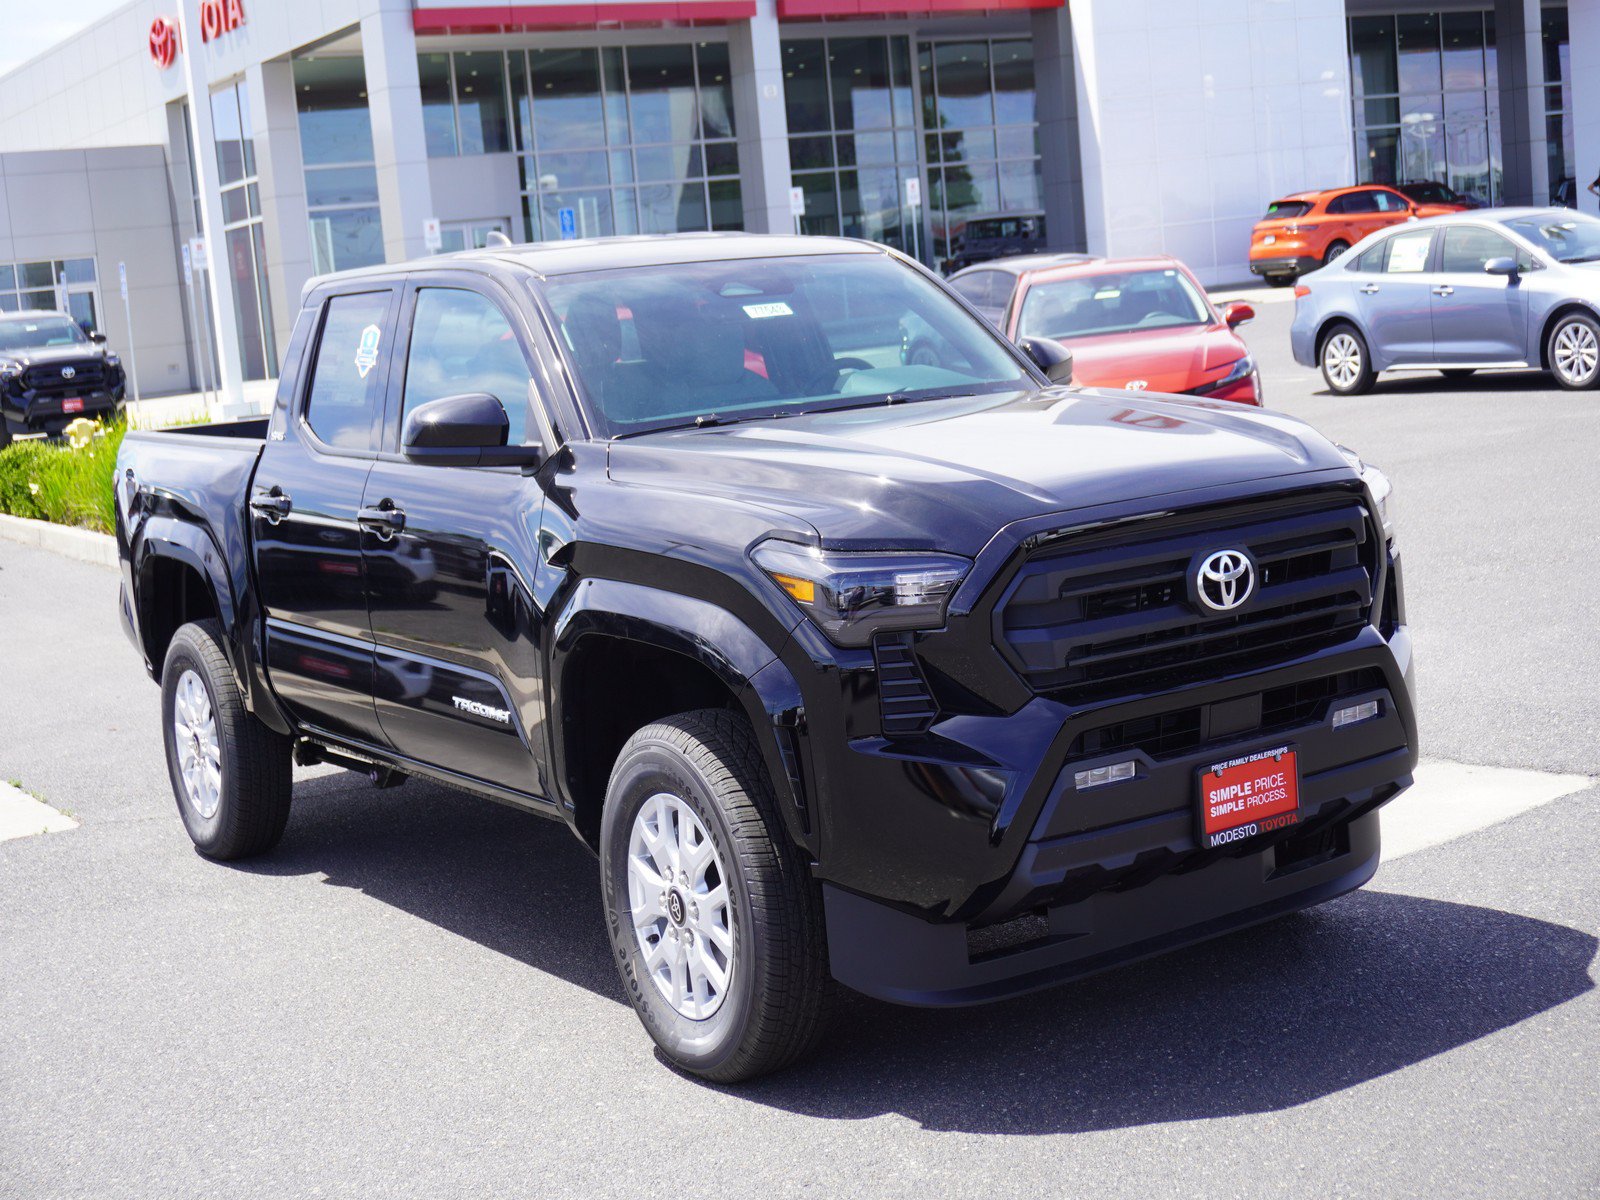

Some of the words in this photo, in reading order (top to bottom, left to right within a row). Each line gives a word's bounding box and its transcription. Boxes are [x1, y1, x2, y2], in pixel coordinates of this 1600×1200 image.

[451, 695, 511, 724] TACOMA
[1211, 762, 1228, 772] PRICE
[1229, 757, 1249, 767] FAMILY
[1249, 747, 1288, 762] DEALERSHIPS
[1209, 782, 1252, 804] SIMPLE
[1254, 772, 1287, 792] PRICE.
[1210, 799, 1245, 817] SIMPLE
[1246, 788, 1288, 808] PROCESS.
[1210, 824, 1257, 847] MODESTO
[1259, 813, 1298, 832] TOYOTA
